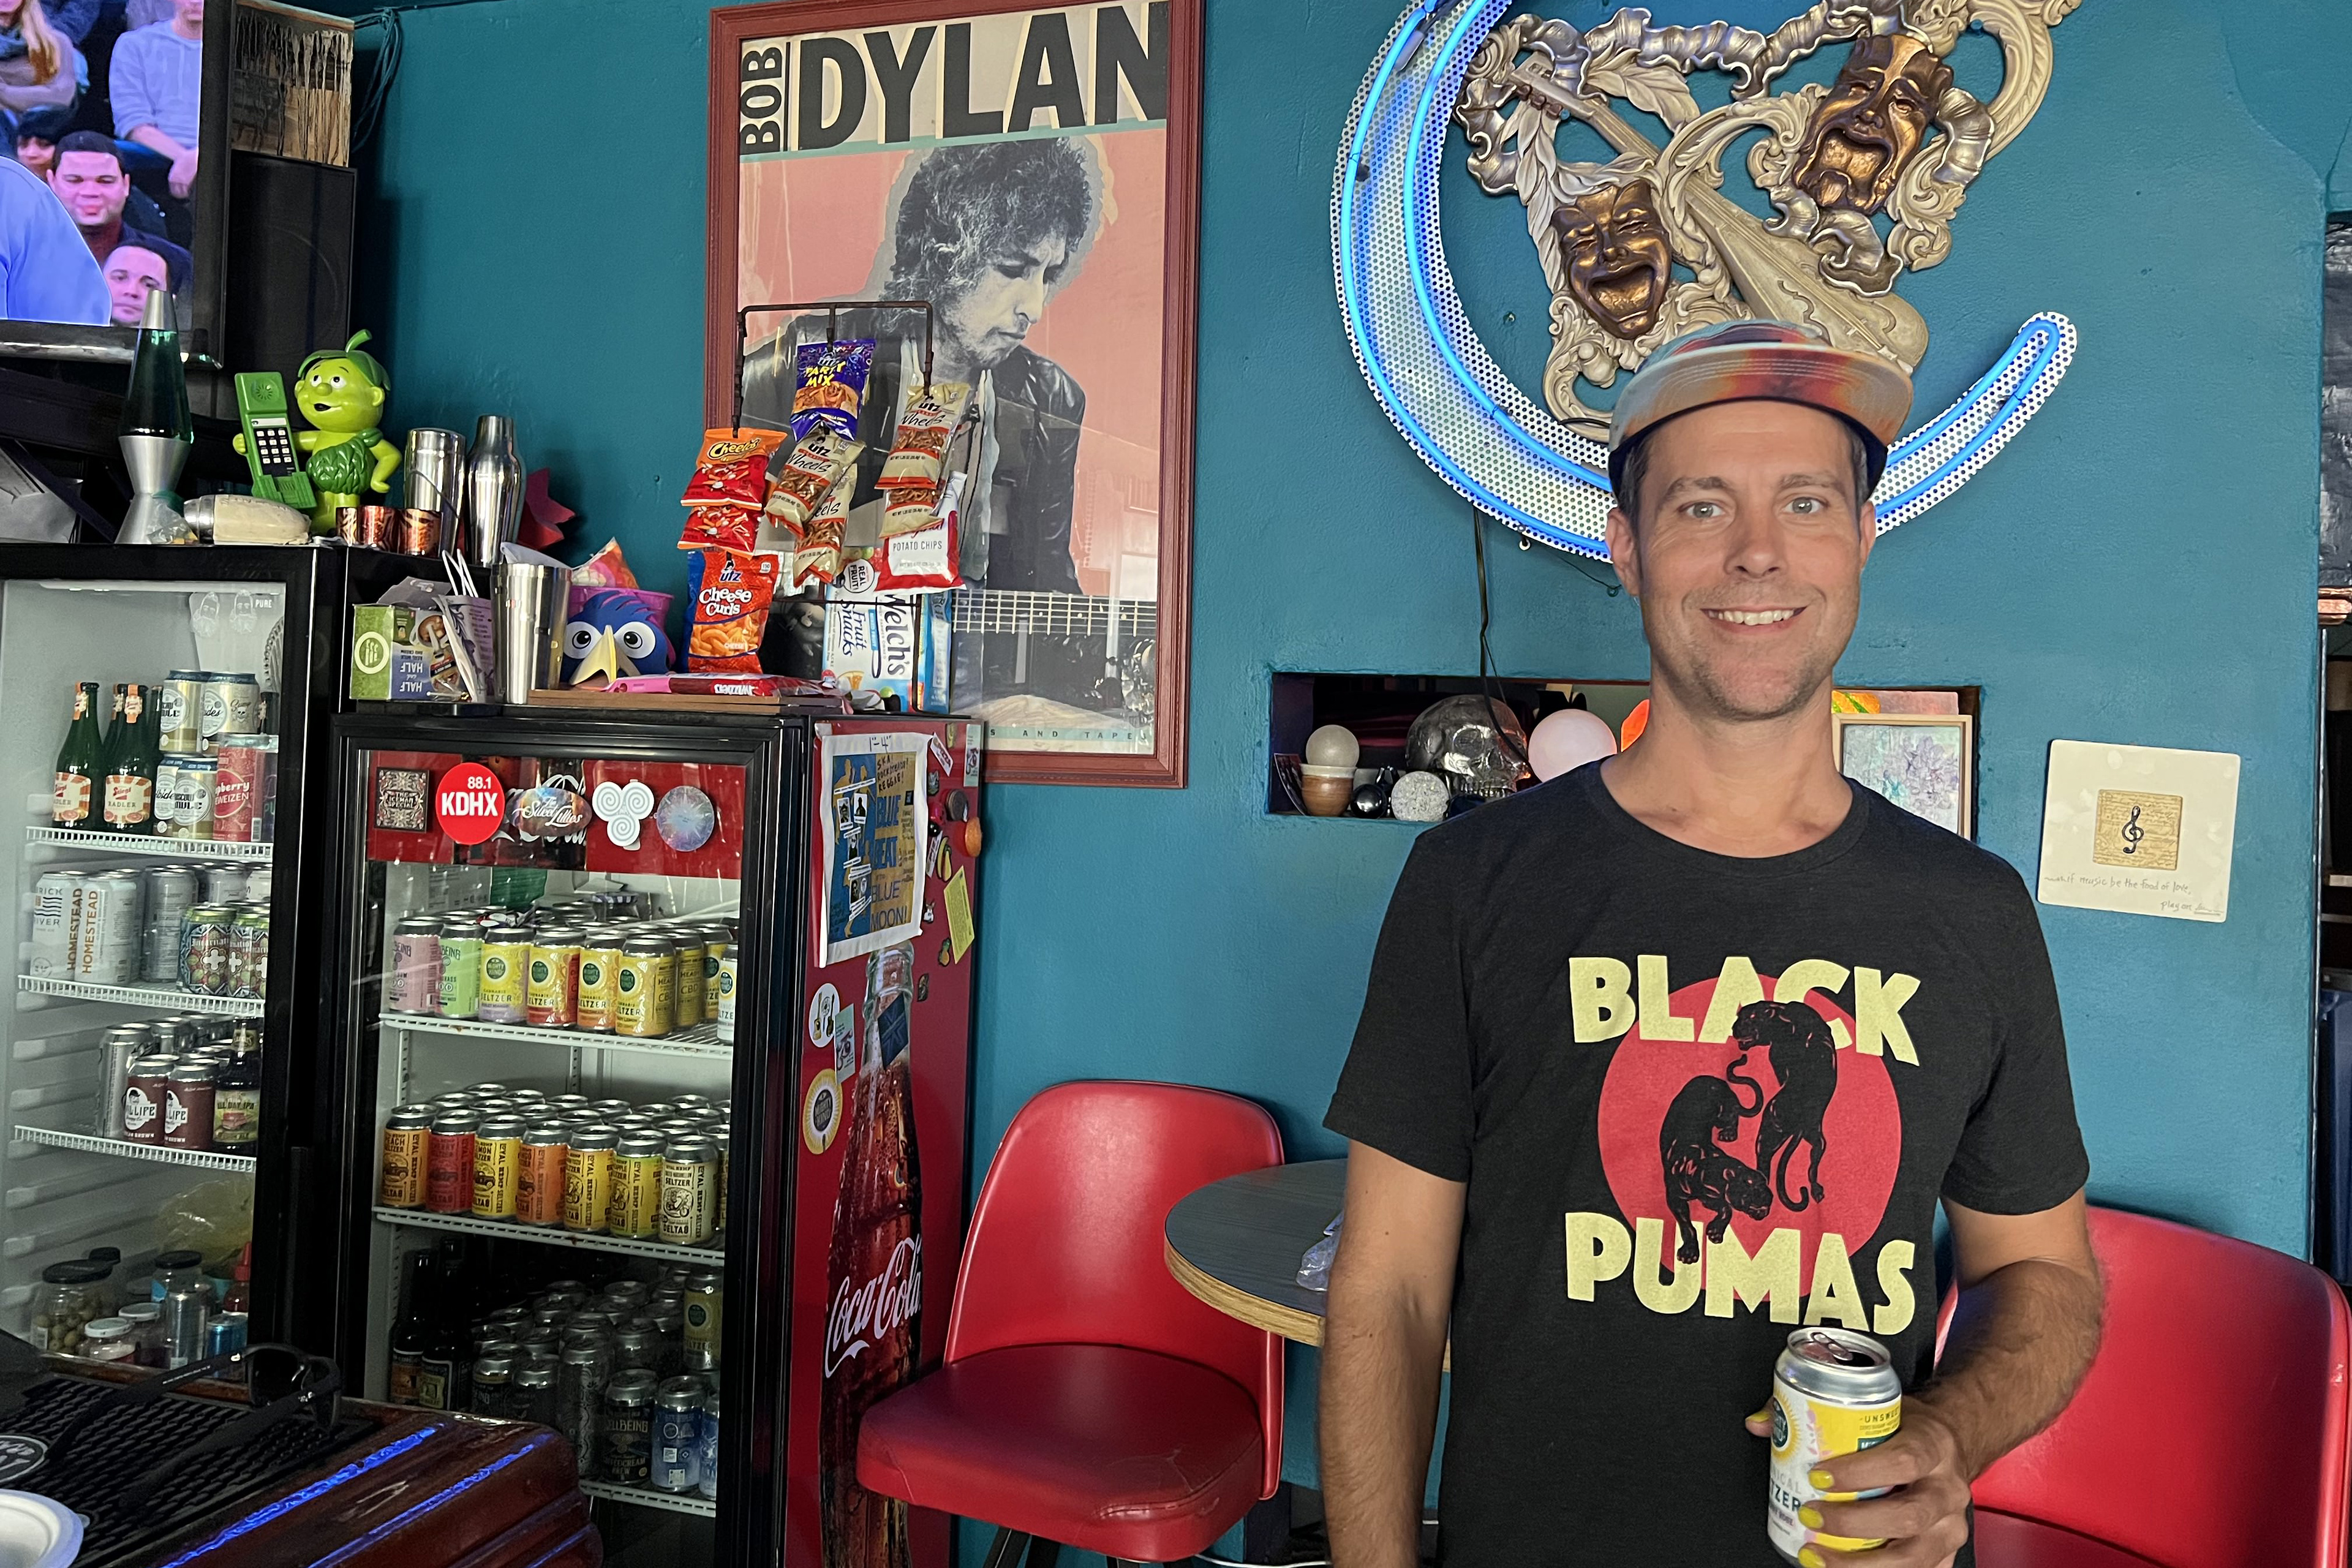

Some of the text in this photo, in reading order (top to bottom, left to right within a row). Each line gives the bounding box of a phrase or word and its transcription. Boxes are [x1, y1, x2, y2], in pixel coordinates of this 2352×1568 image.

[740, 1, 1169, 153] BOB DYLAN
[805, 361, 846, 377] PARTY
[805, 373, 835, 388] MIX
[709, 438, 761, 459] Cheetos
[813, 502, 842, 518] eels
[892, 540, 942, 551] POTATO CHIPS
[849, 564, 859, 590] FRUIT!
[858, 565, 867, 586] REAL
[699, 587, 753, 604] Cheese
[255, 598, 273, 609] PURE
[706, 602, 741, 616] Curls
[841, 600, 855, 657] Snacks
[852, 611, 867, 651] Fruit
[884, 594, 911, 676] Welch's
[400, 662, 423, 673] HALF
[399, 681, 423, 692] HALF
[162, 709, 180, 718] ULE
[1023, 729, 1058, 738] AND
[215, 782, 250, 795] pberry
[467, 776, 491, 790] 88.1
[878, 771, 904, 793] REGGAE!
[215, 793, 249, 805] EWEIZEN
[441, 791, 498, 816] KDHX
[876, 794, 902, 829] BLUE
[2079, 876, 2108, 888] music
[2109, 876, 2121, 888] be
[2124, 878, 2138, 889] the
[2140, 879, 2159, 891] food
[2160, 881, 2171, 891] of
[872, 880, 901, 903] BLUE
[2160, 900, 2180, 911] play
[870, 905, 908, 932] MOON!
[66, 888, 83, 971] HOMESTEAD
[81, 891, 98, 974] HOMESTEAD
[393, 941, 412, 957] BEING
[440, 945, 461, 960] BEING
[680, 984, 698, 994] CBD
[579, 999, 606, 1008] ELTZER
[658, 993, 673, 1002] CB
[617, 1006, 641, 1016] ELTZER
[718, 1010, 734, 1019] LTZE
[1569, 954, 1921, 1066] BLACK
[411, 1134, 420, 1155] LOYAL
[432, 1142, 454, 1152] HERRY
[475, 1145, 492, 1154] EMON
[498, 1143, 507, 1164] LOYAL
[566, 1165, 581, 1174] LTZER
[587, 1155, 595, 1176] LOYAL
[633, 1161, 641, 1183] LOYAL
[665, 1177, 690, 1186] SELTZER
[474, 1198, 490, 1208] LTA8
[566, 1211, 579, 1220] LTA8
[663, 1224, 689, 1234] DELTA8
[1565, 1212, 1915, 1335] PUMAS
[1865, 1405, 1899, 1423] UNSWEE
[606, 1419, 649, 1433] ELLBEING
[1771, 1477, 1802, 1512] TZER
